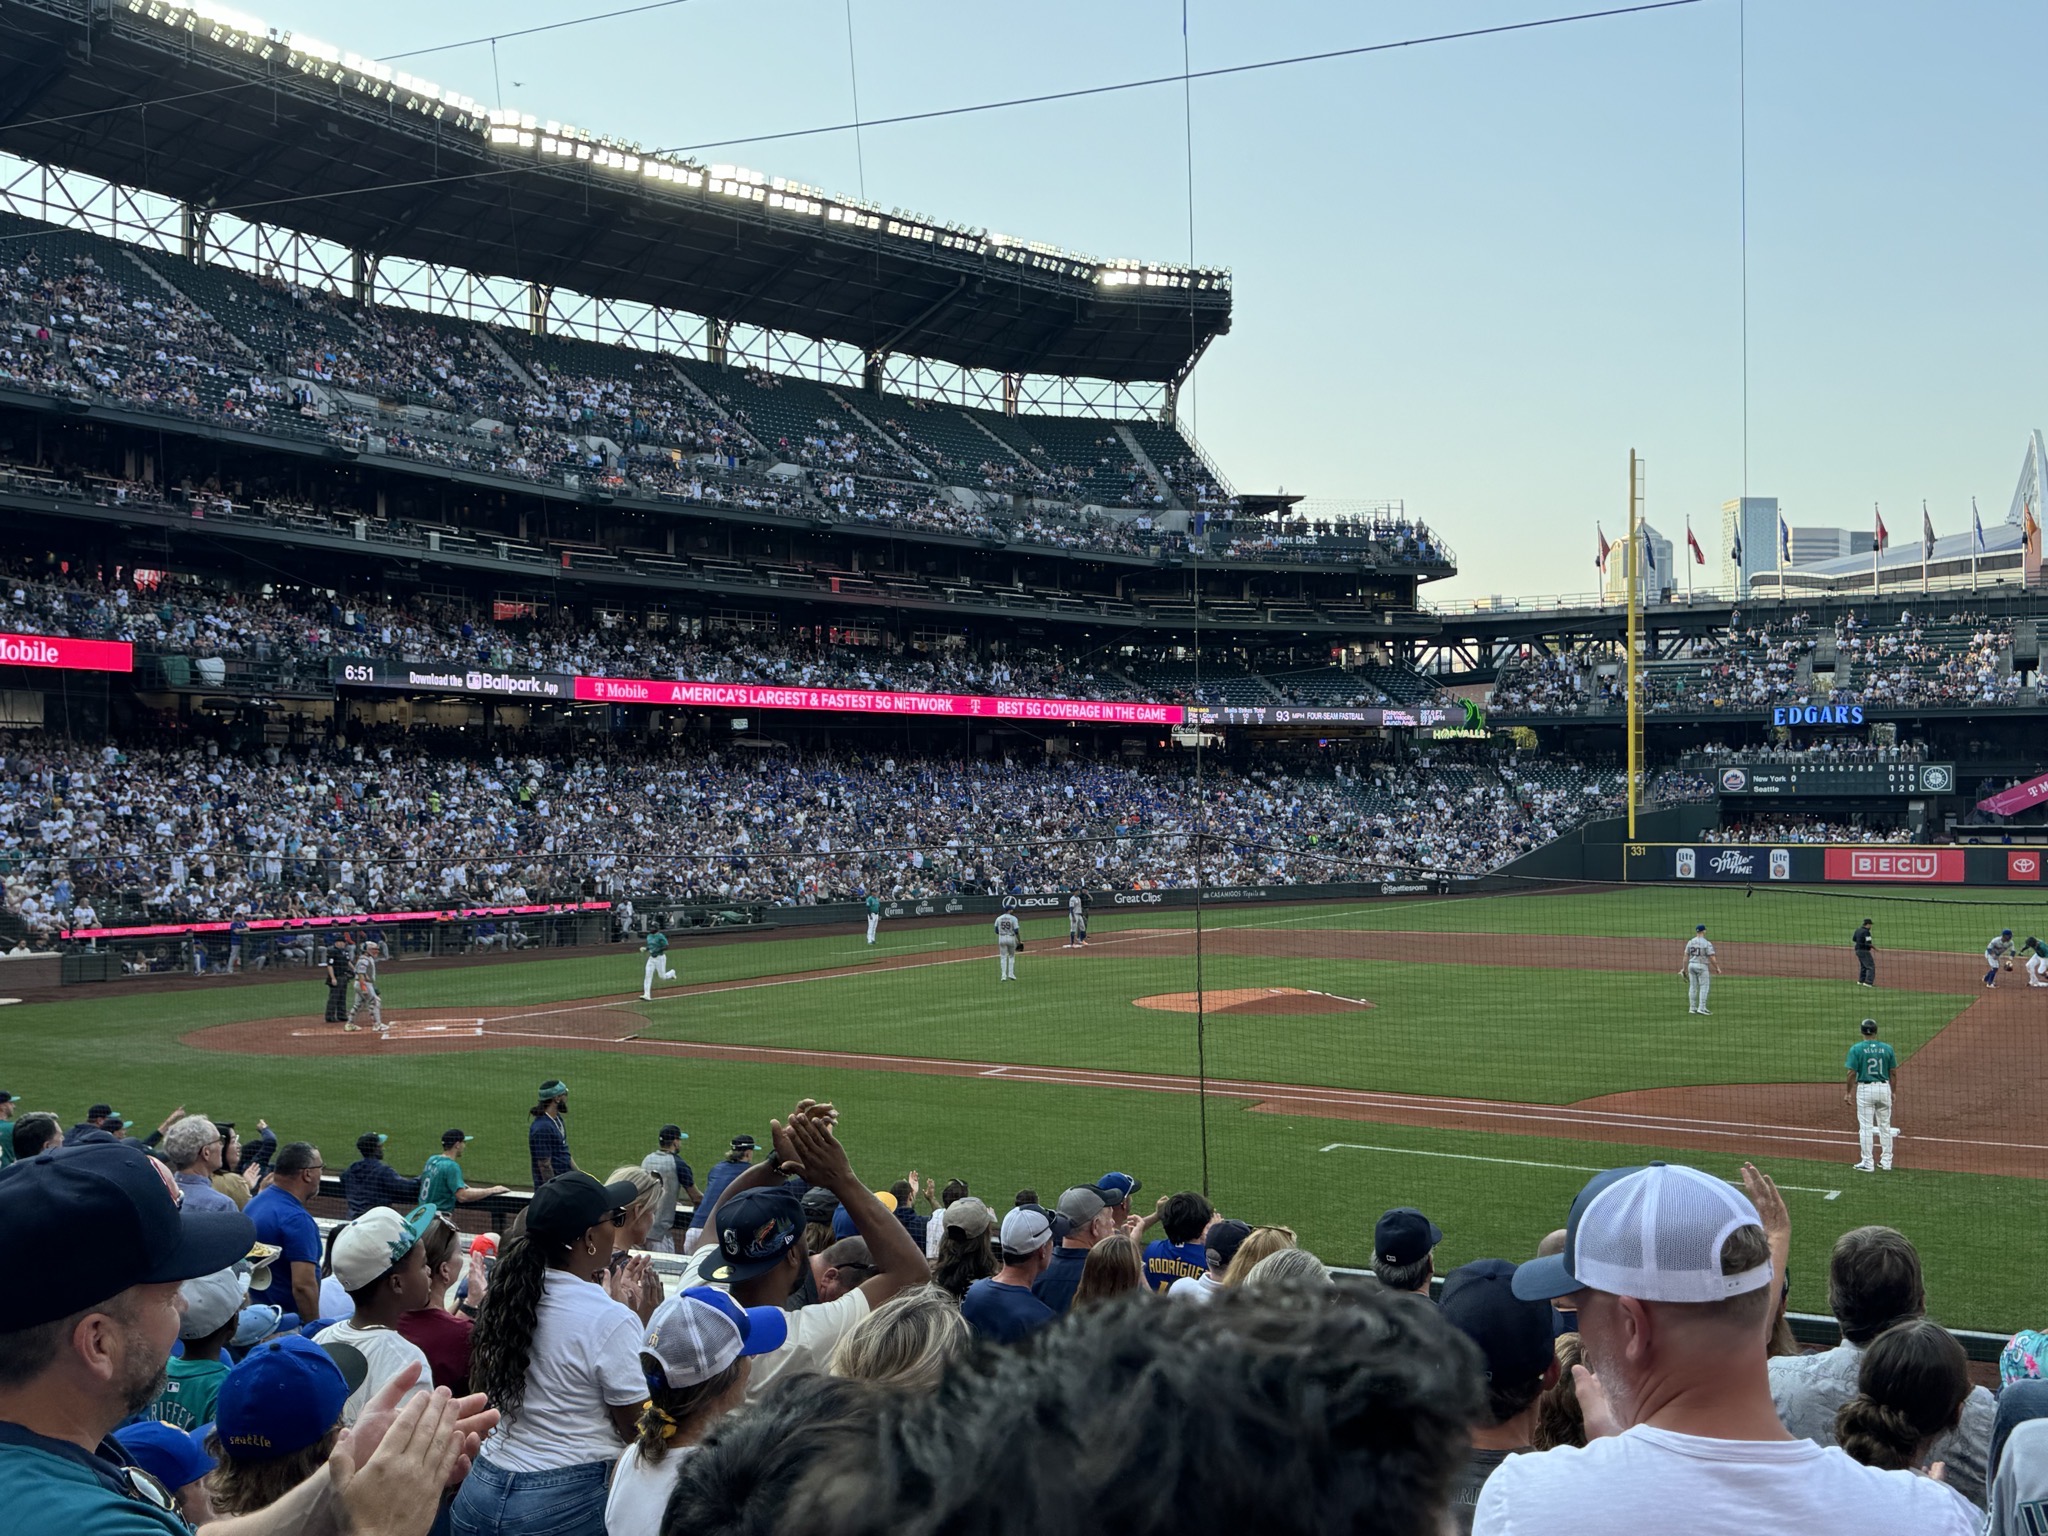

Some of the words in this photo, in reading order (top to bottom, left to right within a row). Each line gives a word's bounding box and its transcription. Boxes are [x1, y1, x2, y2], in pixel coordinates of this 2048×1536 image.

[1296, 535, 1318, 544] Deck
[344, 665, 374, 682] 6:51
[410, 671, 448, 686] Download
[450, 674, 463, 687] the
[544, 682, 558, 696] App
[607, 683, 648, 699] Mobile
[672, 686, 747, 702] AMERICA'S
[750, 689, 808, 706] LARGEST
[810, 693, 818, 706] &
[822, 692, 872, 708] FASTEST
[875, 695, 891, 709] 5G
[894, 696, 954, 712] NETWORK
[997, 701, 1024, 715] BEST
[1026, 702, 1041, 716] 5G
[1043, 703, 1100, 718] COVERAGE
[1102, 706, 1114, 718] IN
[1115, 706, 1134, 720] THE
[1136, 706, 1166, 720] GAME
[1276, 711, 1289, 721] 93
[1774, 705, 1863, 726] EDGAR'S
[1630, 846, 1646, 856] 331
[1722, 850, 1740, 858] IT'S
[1679, 853, 1693, 862] Lite
[1772, 854, 1787, 863] Lite
[1710, 856, 1754, 873] Miller
[1730, 866, 1752, 874] TIME
[1858, 858, 1932, 872] BECU
[1018, 898, 1059, 907] LEXUS
[1114, 894, 1140, 904] Great
[1141, 892, 1162, 904] Clips
[885, 907, 904, 917] Corona
[916, 905, 934, 915] Corona
[945, 904, 963, 913] Corona
[1001, 922, 1011, 930] 59
[1868, 1058, 1883, 1074] 21
[1149, 1256, 1209, 1281] RODRÍGUE
[230, 1435, 272, 1448] seattle
